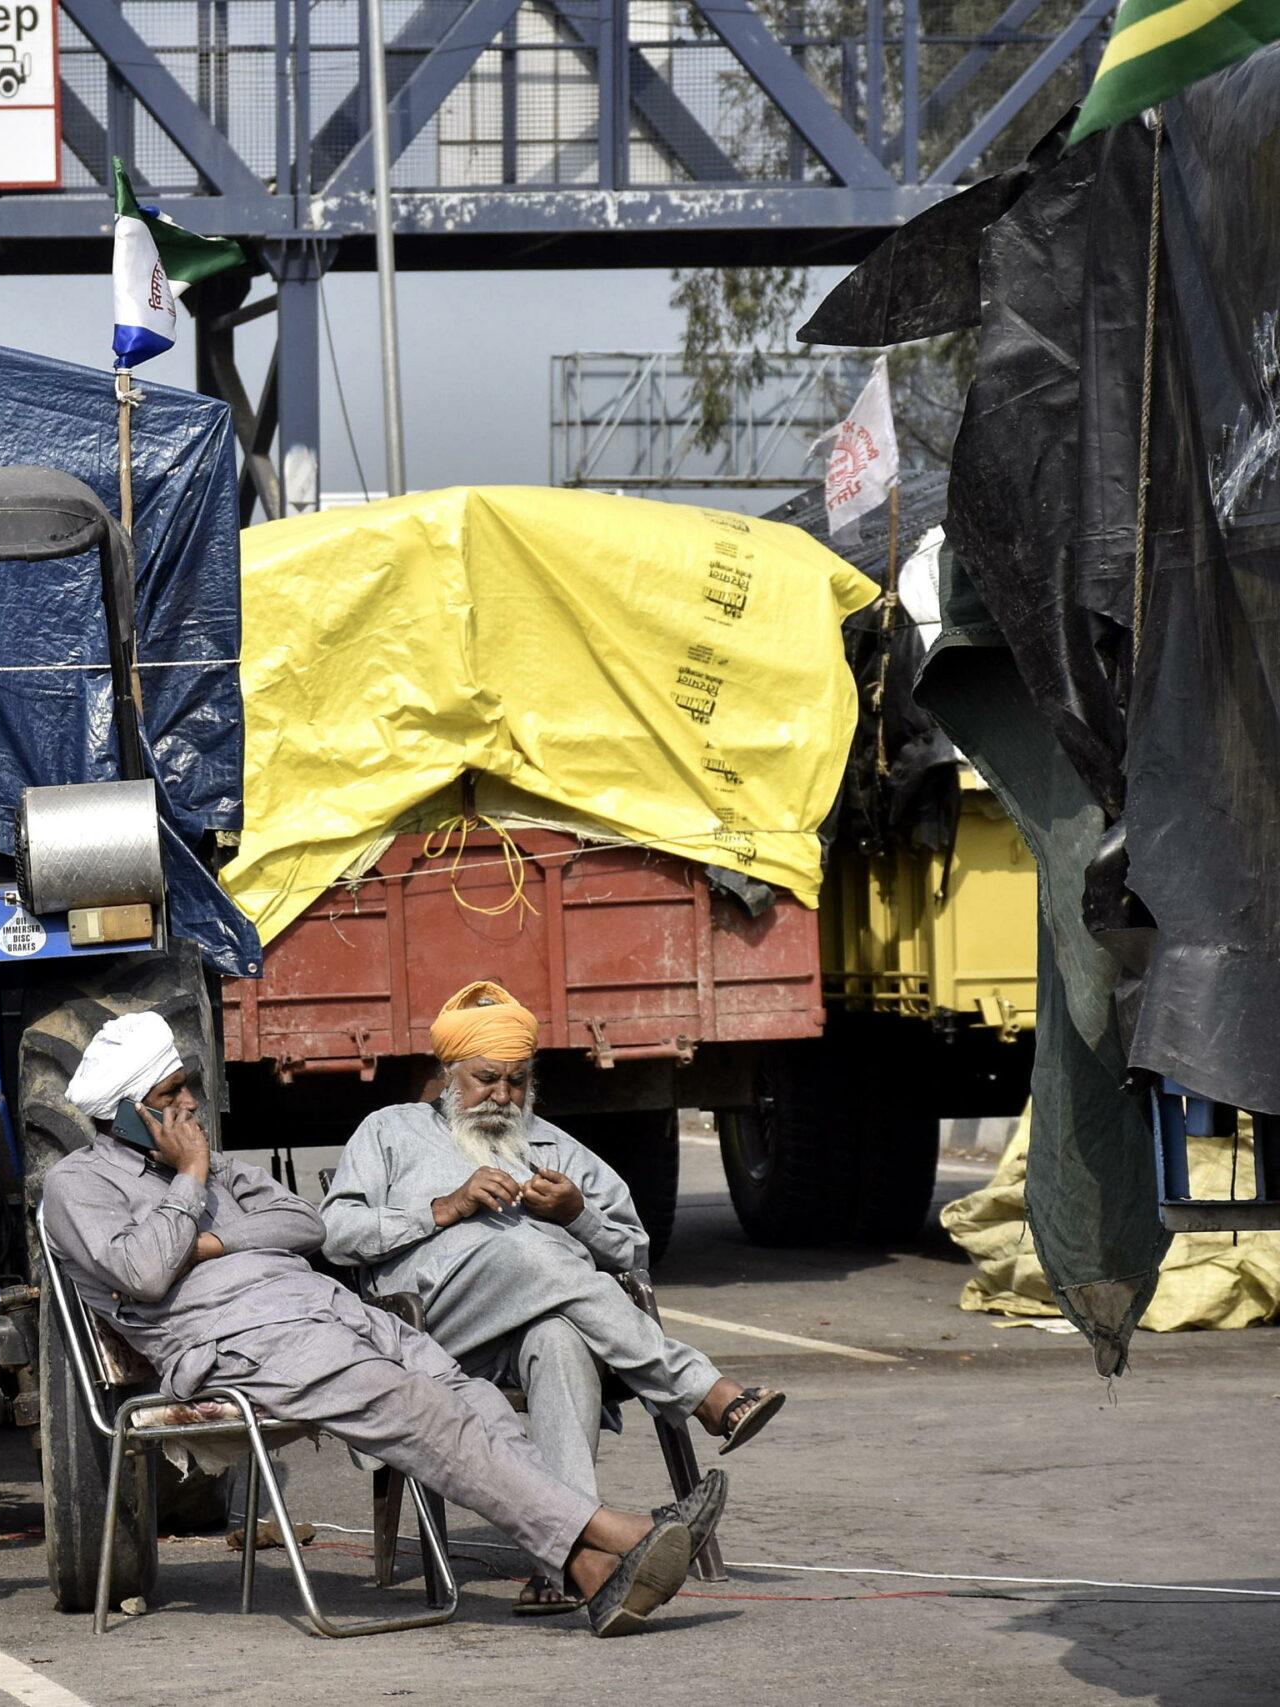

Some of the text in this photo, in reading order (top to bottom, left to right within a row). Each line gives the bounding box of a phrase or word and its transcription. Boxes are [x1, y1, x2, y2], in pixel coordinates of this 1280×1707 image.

[15, 917, 27, 925] OIL
[2, 924, 41, 934] IMMERSED
[13, 934, 31, 943] DISC
[7, 942, 36, 952] BRAKES
